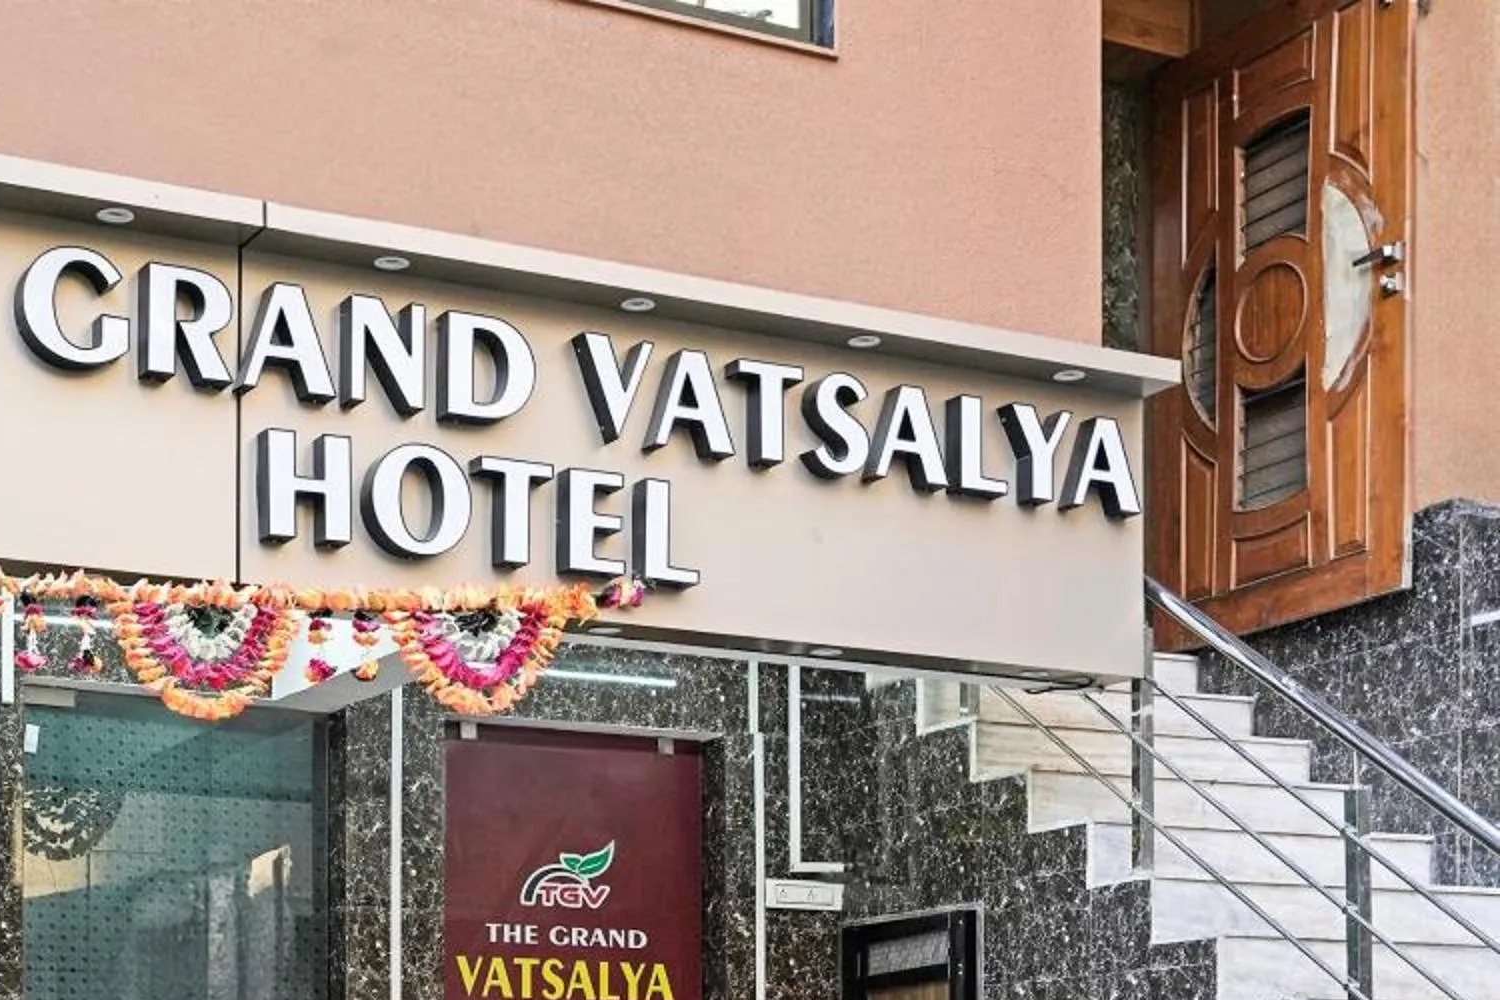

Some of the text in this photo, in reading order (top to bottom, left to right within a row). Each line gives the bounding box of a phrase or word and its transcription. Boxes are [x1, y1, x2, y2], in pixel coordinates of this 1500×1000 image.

[13, 246, 537, 425] GRAND
[571, 331, 1142, 520] VATSALYA
[256, 428, 700, 588] HOTEL
[485, 923, 648, 949] THE GRAND
[538, 882, 611, 909] TGV
